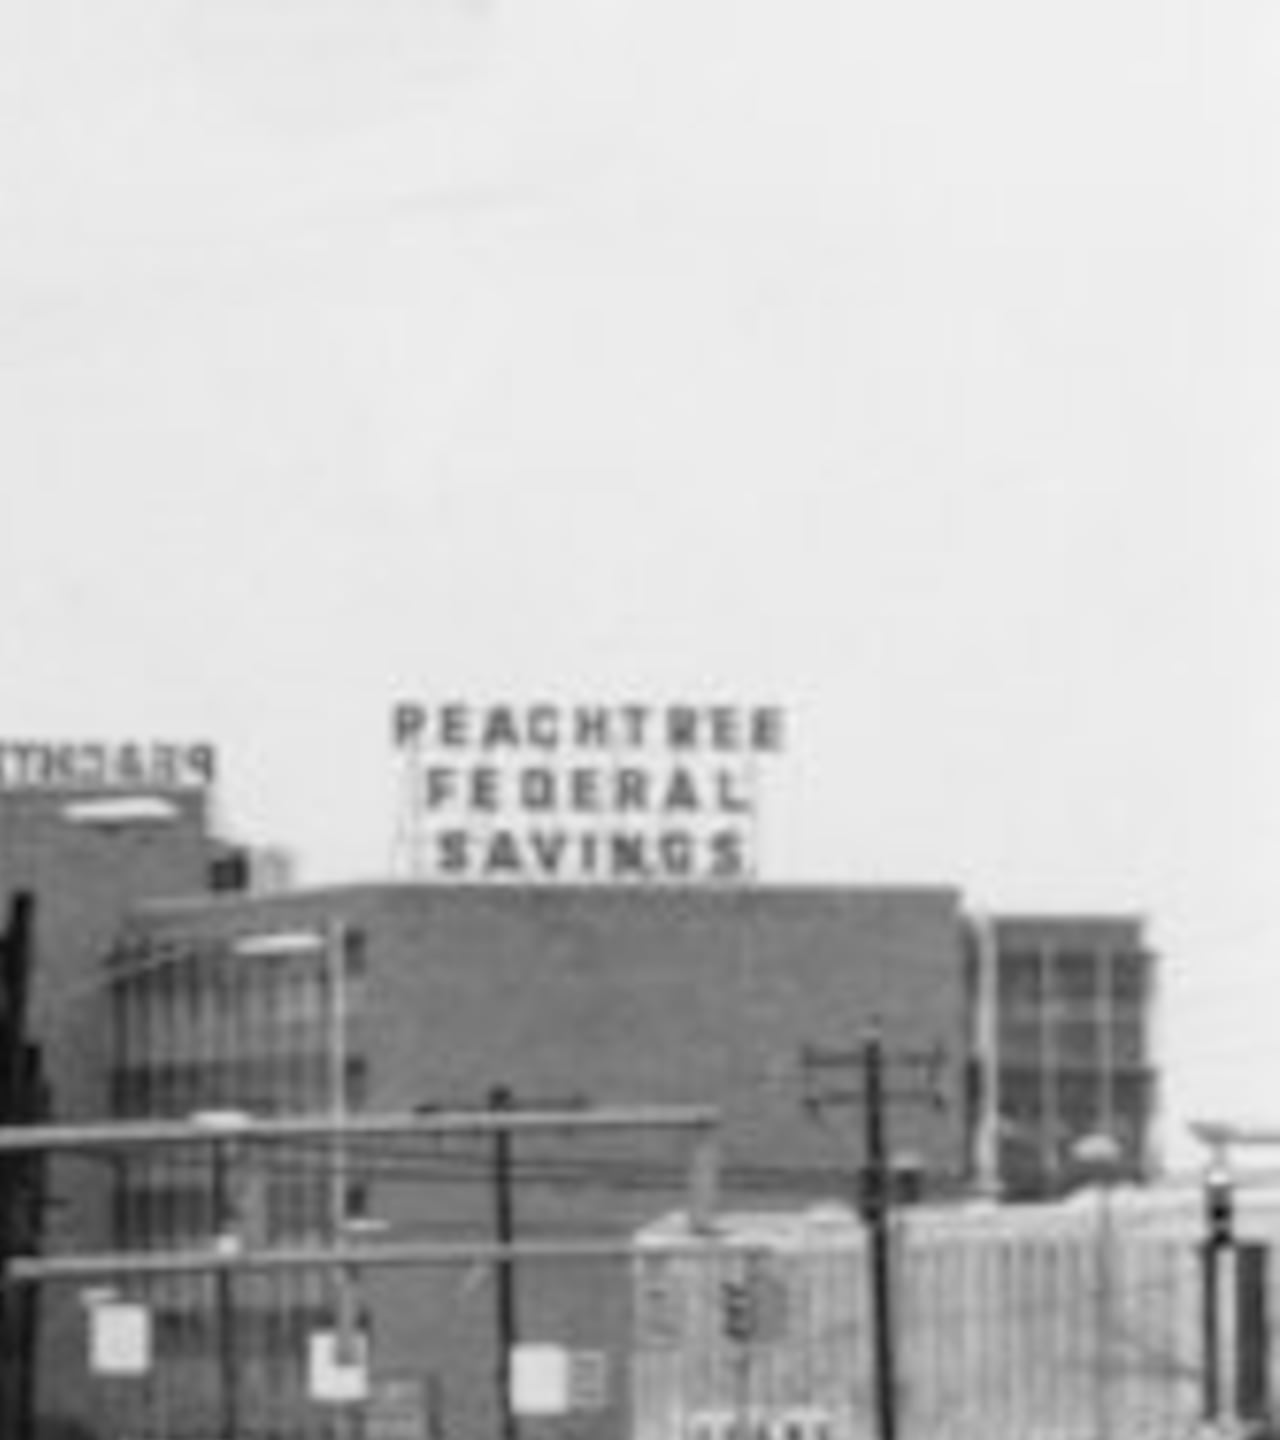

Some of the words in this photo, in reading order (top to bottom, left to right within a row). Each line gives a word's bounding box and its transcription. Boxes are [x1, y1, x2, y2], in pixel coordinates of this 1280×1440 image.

[390, 703, 784, 752] PEACHTREE
[426, 767, 754, 813] FEDERAL
[439, 829, 744, 876] SAVINGS
